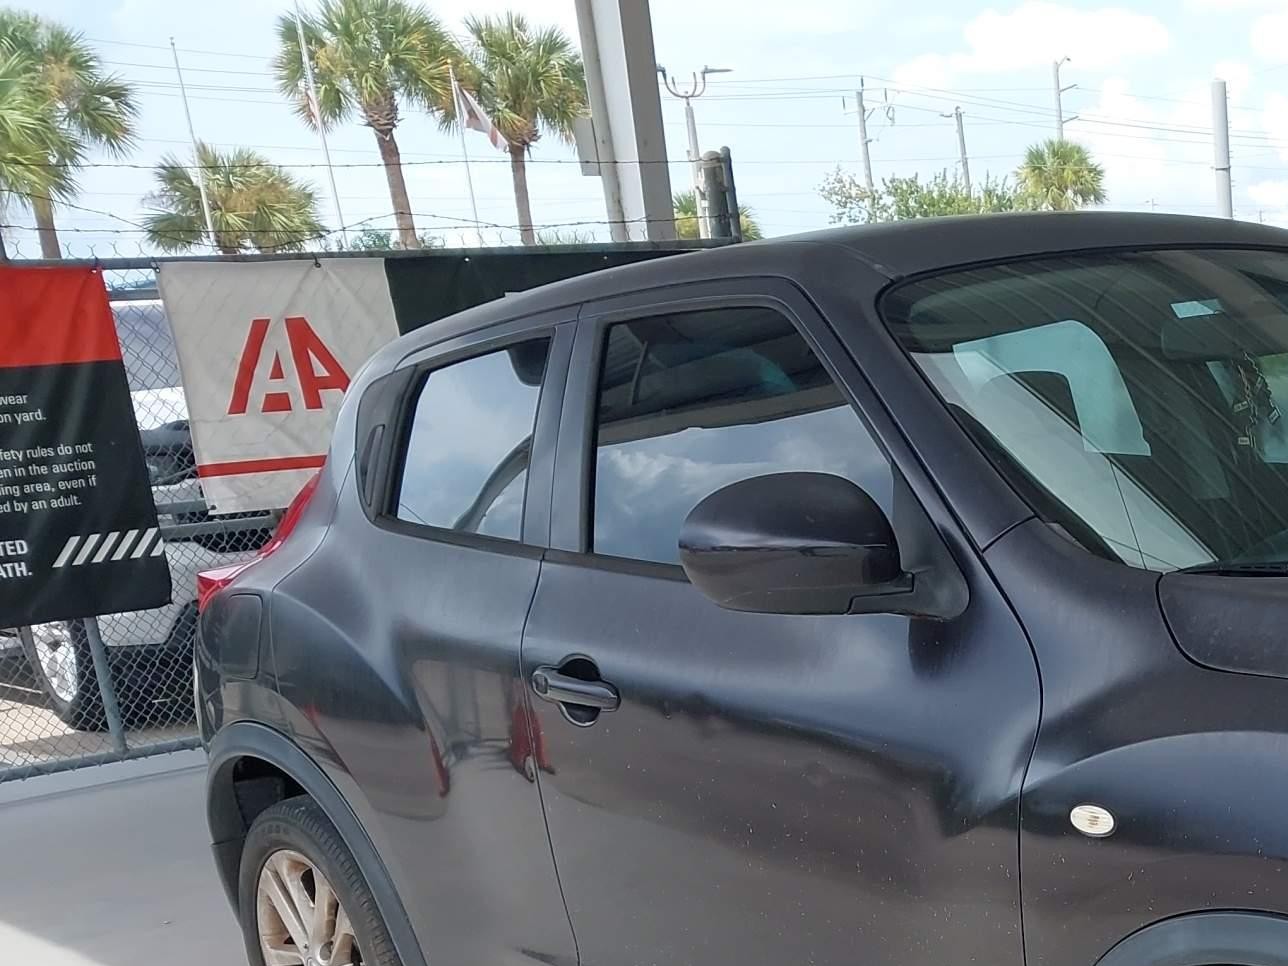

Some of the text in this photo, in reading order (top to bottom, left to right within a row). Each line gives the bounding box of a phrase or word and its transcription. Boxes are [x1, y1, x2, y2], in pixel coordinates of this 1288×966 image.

[14, 408, 47, 425] yard.
[26, 445, 55, 459] rules
[57, 443, 73, 456] do
[75, 442, 93, 454] not
[14, 465, 26, 477] in
[29, 463, 49, 475] the
[52, 458, 96, 473] auction
[24, 481, 55, 494] area,
[58, 478, 86, 490] even
[88, 474, 97, 487] if
[13, 500, 28, 514] by
[31, 499, 47, 510] an
[50, 494, 82, 508] adult.
